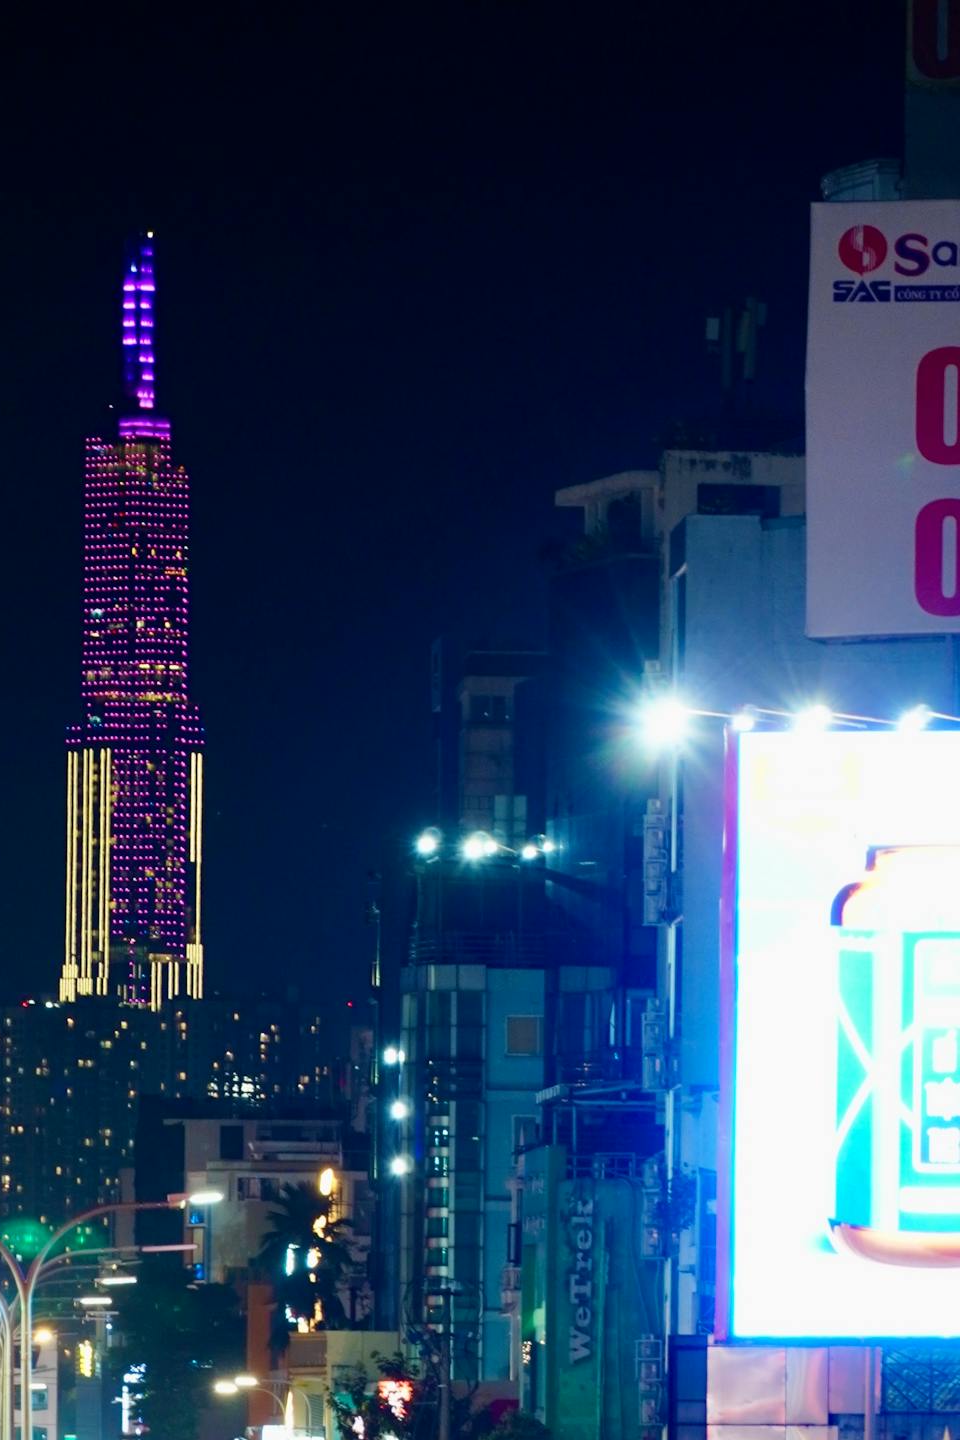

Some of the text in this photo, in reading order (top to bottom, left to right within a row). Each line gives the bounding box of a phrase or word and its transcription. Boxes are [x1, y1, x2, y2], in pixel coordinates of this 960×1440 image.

[894, 233, 960, 276] Sa
[928, 289, 942, 300] TY
[568, 1198, 594, 1365] WeTrek
